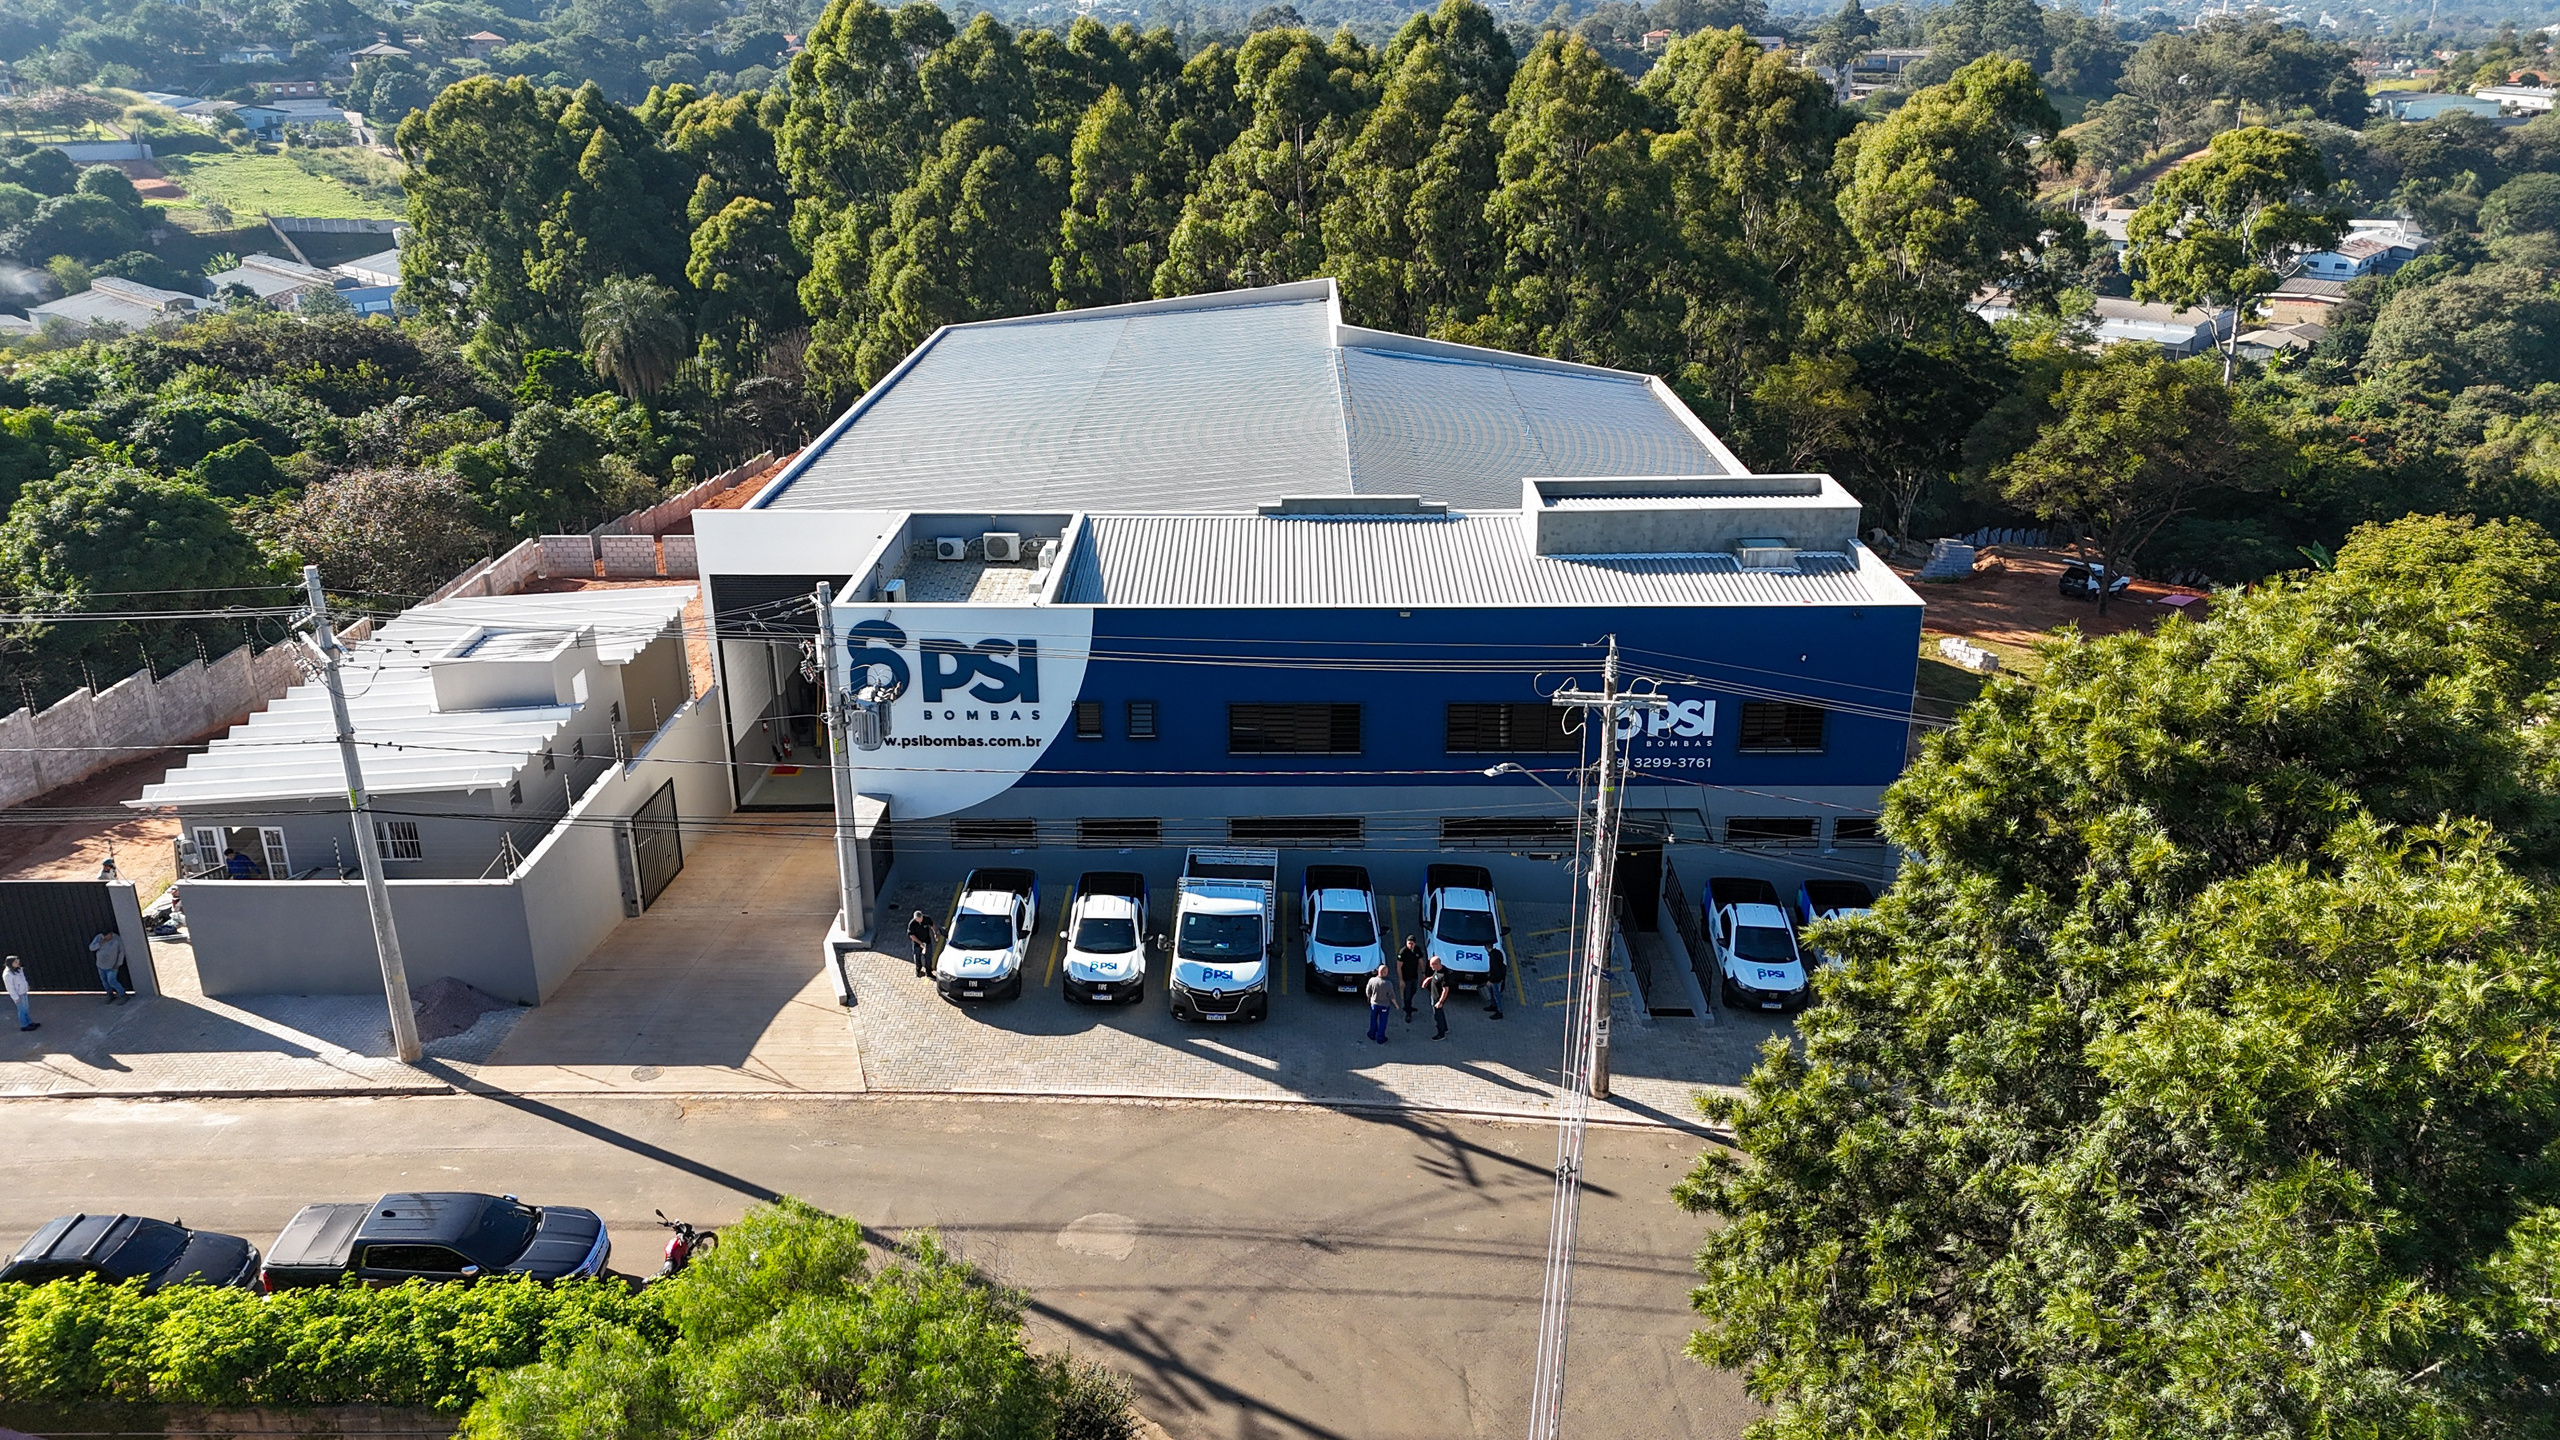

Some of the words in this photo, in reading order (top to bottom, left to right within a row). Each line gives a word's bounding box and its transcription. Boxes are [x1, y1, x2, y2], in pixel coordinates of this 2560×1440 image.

[919, 638, 1040, 704] PSI
[924, 710, 1041, 721] BOMBAS
[1647, 700, 1716, 737] PSI
[884, 735, 1042, 749] w.psibombas.com.br
[1616, 757, 1630, 769] 9)
[1634, 757, 1712, 768] 3299-3761
[1344, 954, 1361, 962] PSI
[1466, 952, 1482, 961] PSI
[1100, 962, 1117, 970] PSI
[1214, 970, 1233, 979] PSI
[1767, 970, 1785, 979] PSI
